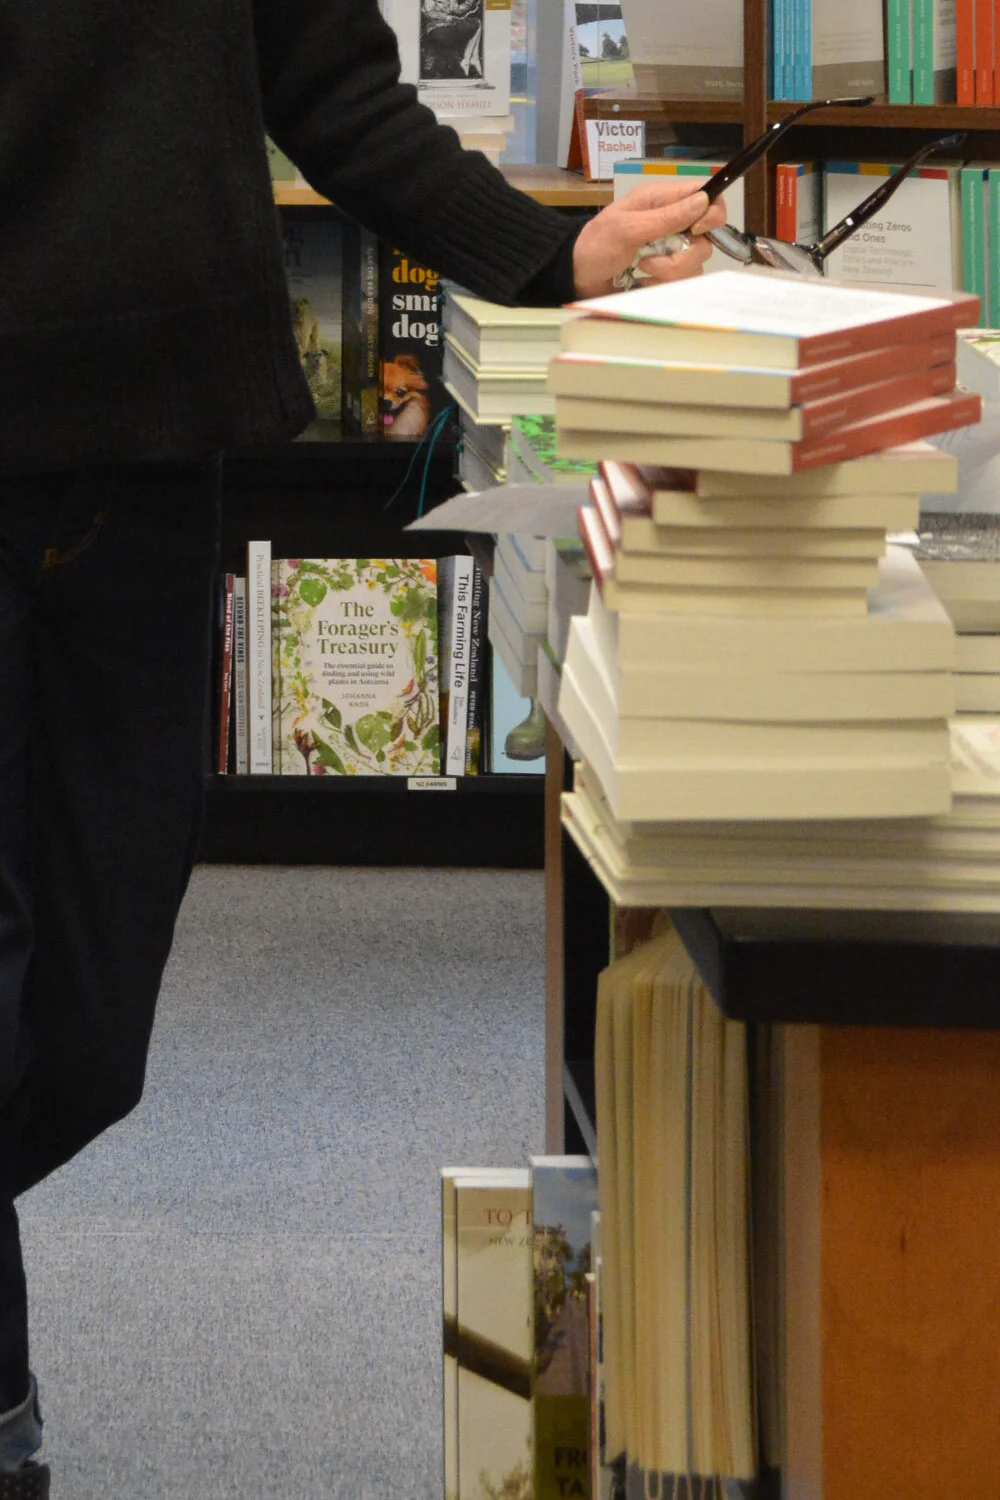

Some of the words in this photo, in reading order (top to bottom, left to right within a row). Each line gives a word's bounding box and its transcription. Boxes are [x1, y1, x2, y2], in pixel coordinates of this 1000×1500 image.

[598, 140, 637, 152] Rachel
[458, 574, 469, 601] This
[340, 601, 375, 618] The
[317, 620, 399, 640] Forager's
[453, 603, 468, 660] Farming
[317, 638, 399, 659] Treasury
[453, 661, 466, 689] Life
